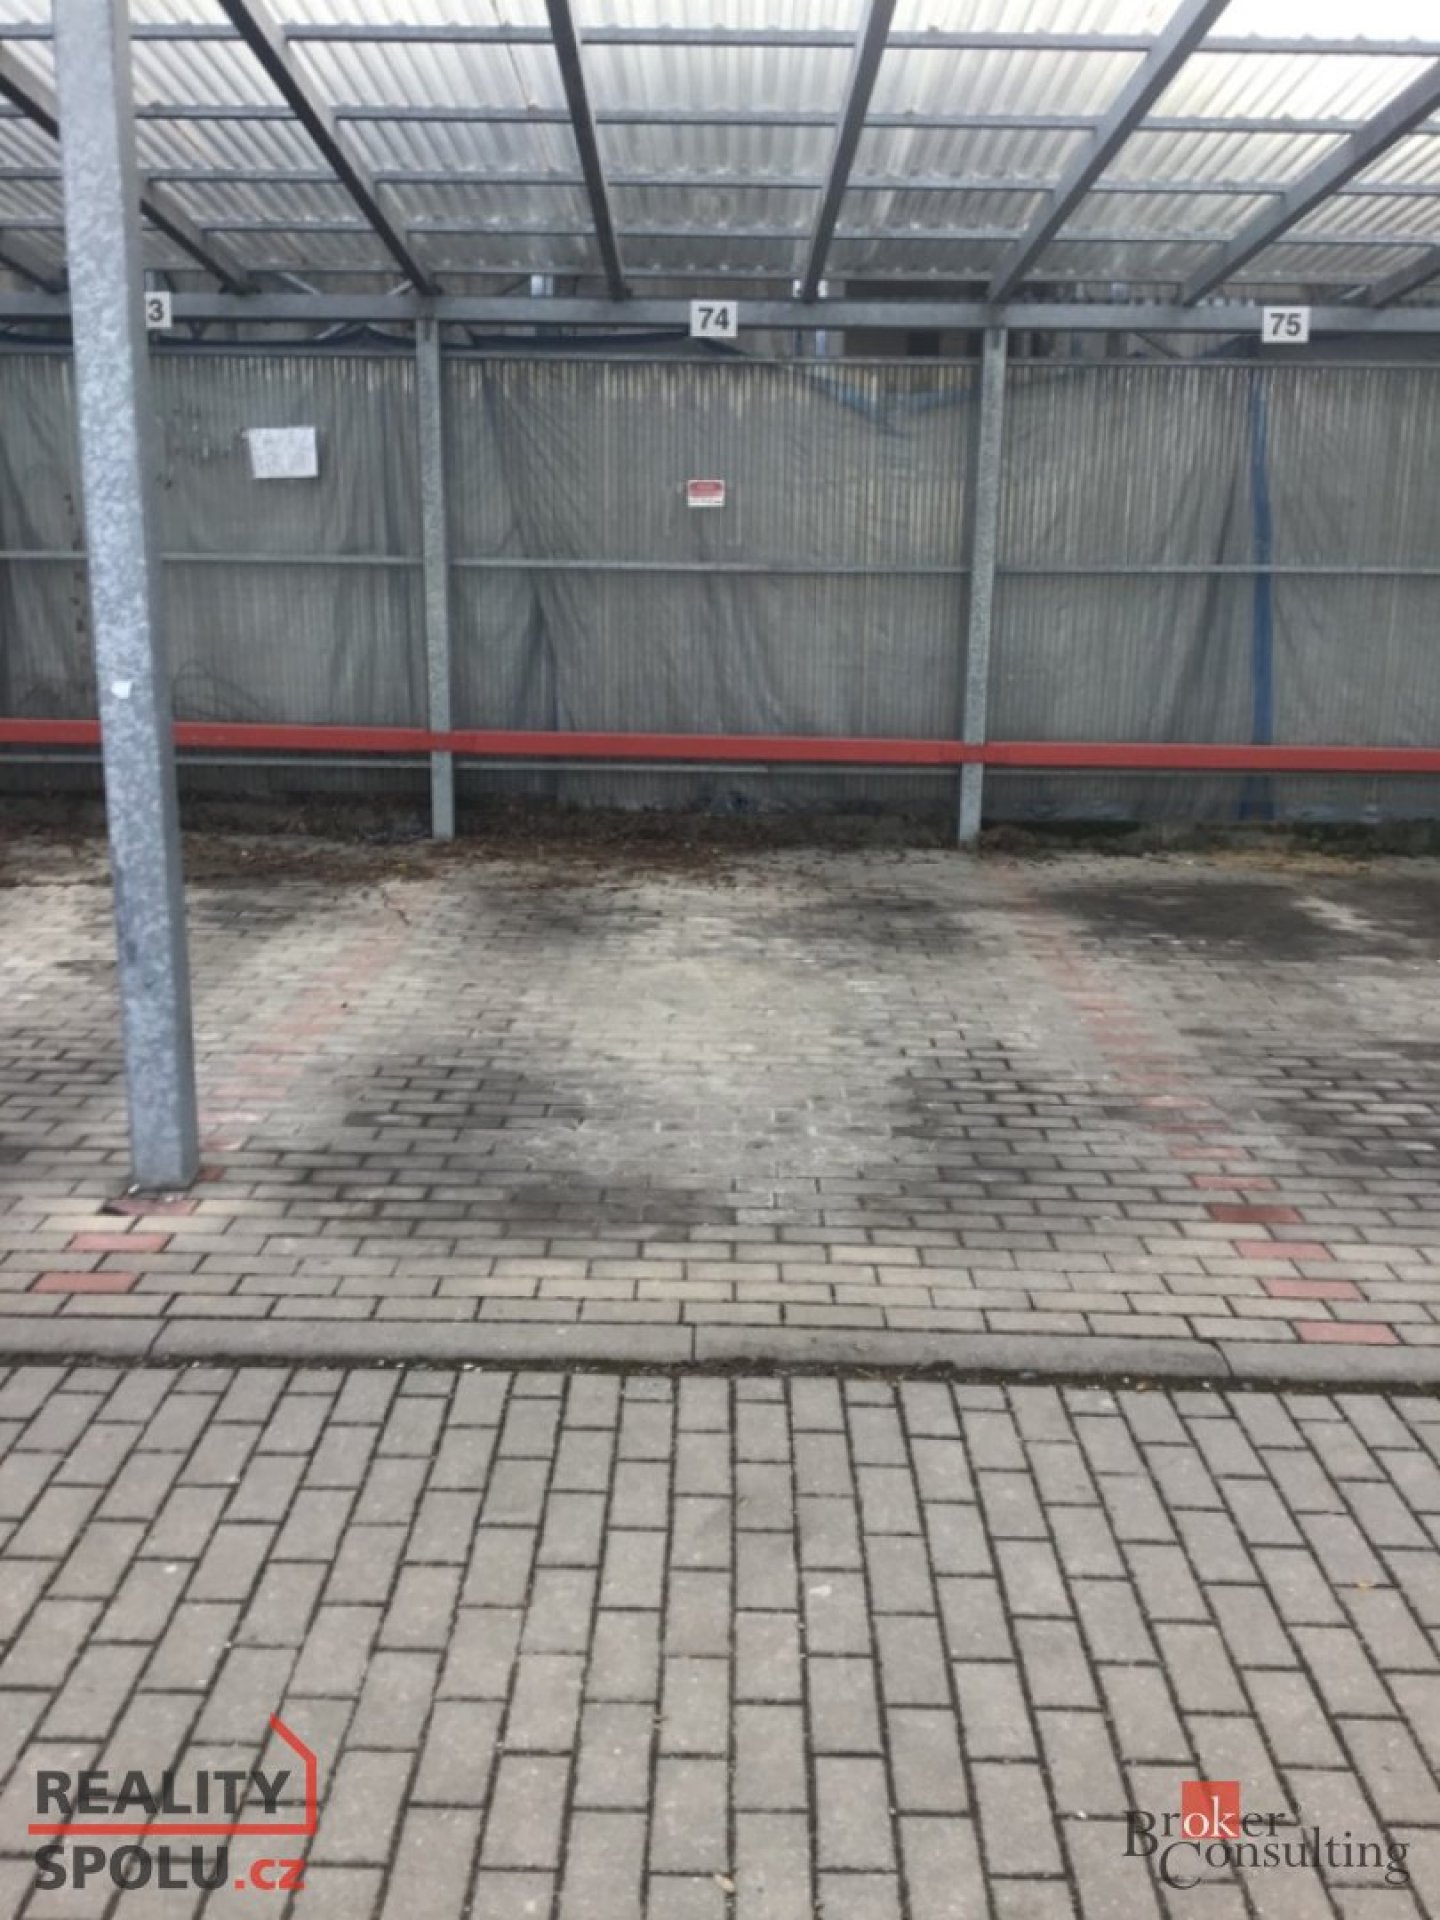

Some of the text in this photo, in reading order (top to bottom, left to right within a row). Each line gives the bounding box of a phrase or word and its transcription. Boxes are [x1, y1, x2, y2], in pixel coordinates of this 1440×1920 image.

[149, 299, 164, 322] 3
[698, 306, 730, 330] 74
[1270, 312, 1301, 337] 75
